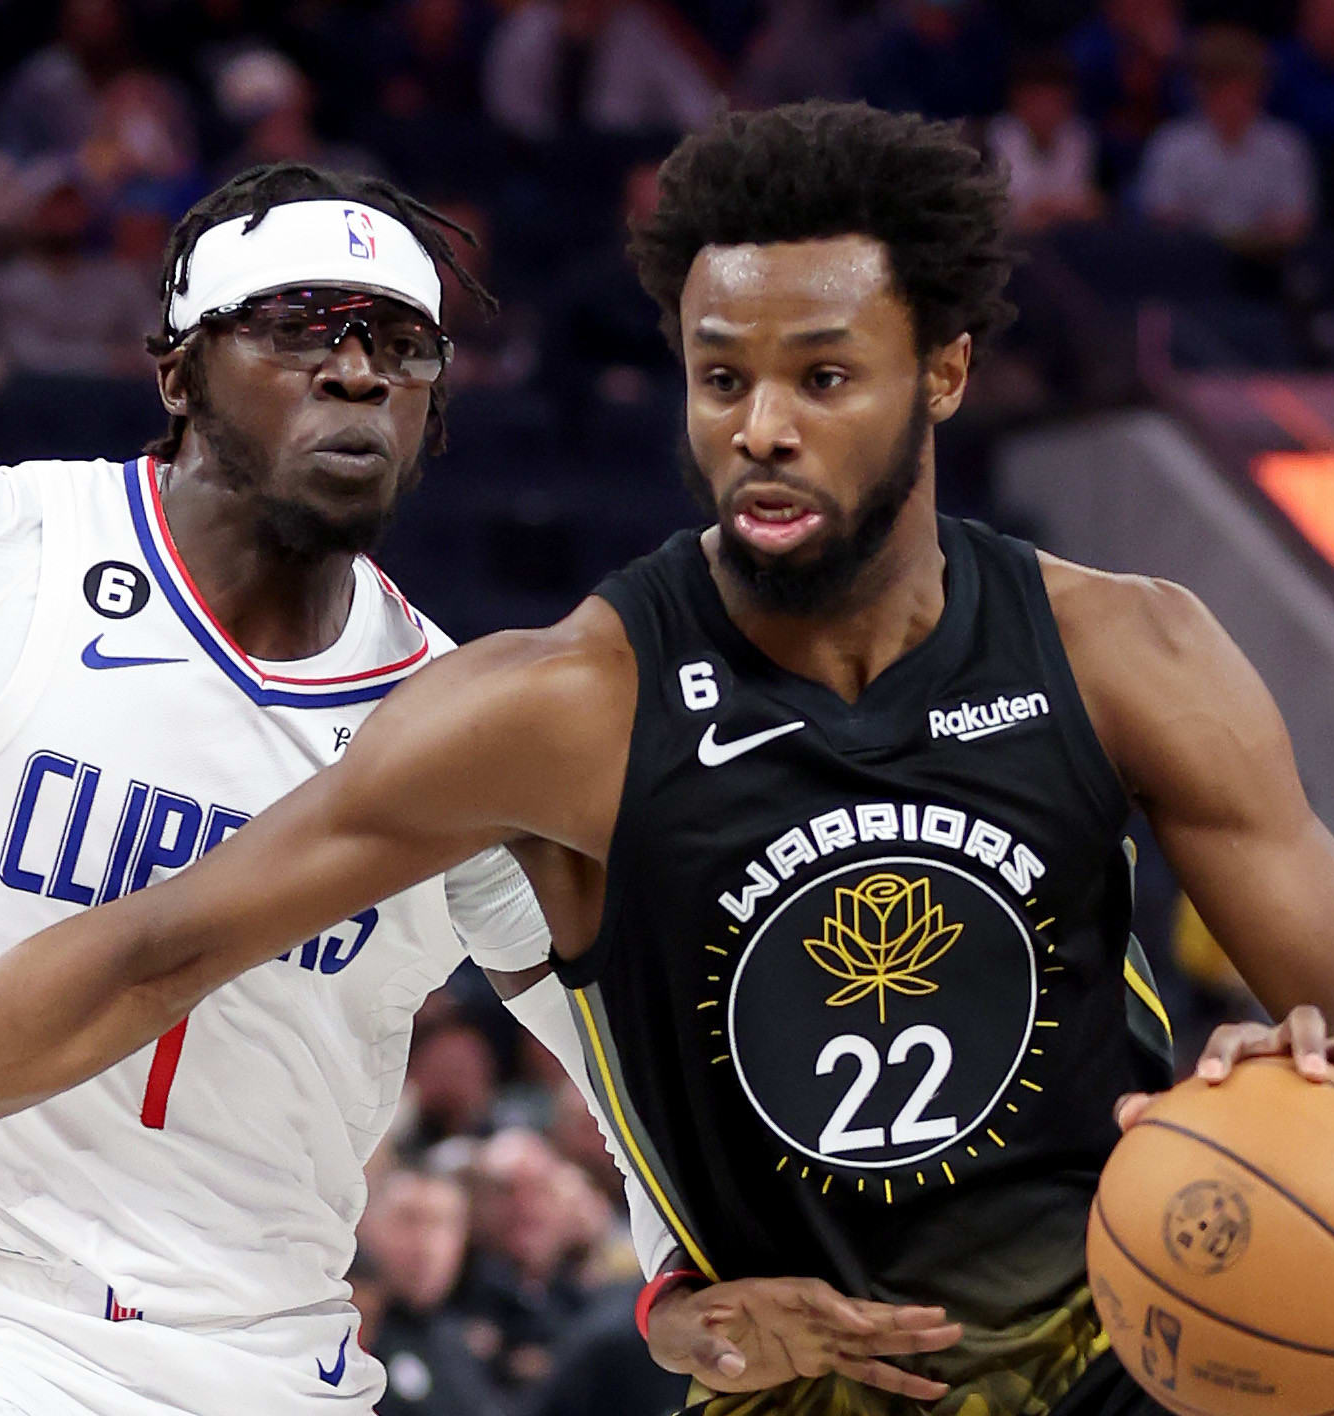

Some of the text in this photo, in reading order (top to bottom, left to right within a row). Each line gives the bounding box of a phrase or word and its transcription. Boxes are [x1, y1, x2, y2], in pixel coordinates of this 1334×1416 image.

[95, 566, 136, 614] 6
[678, 661, 719, 710] 6
[929, 691, 1049, 740] Rakuten
[718, 803, 1046, 923] WARRIORS
[815, 1024, 958, 1154] 22
